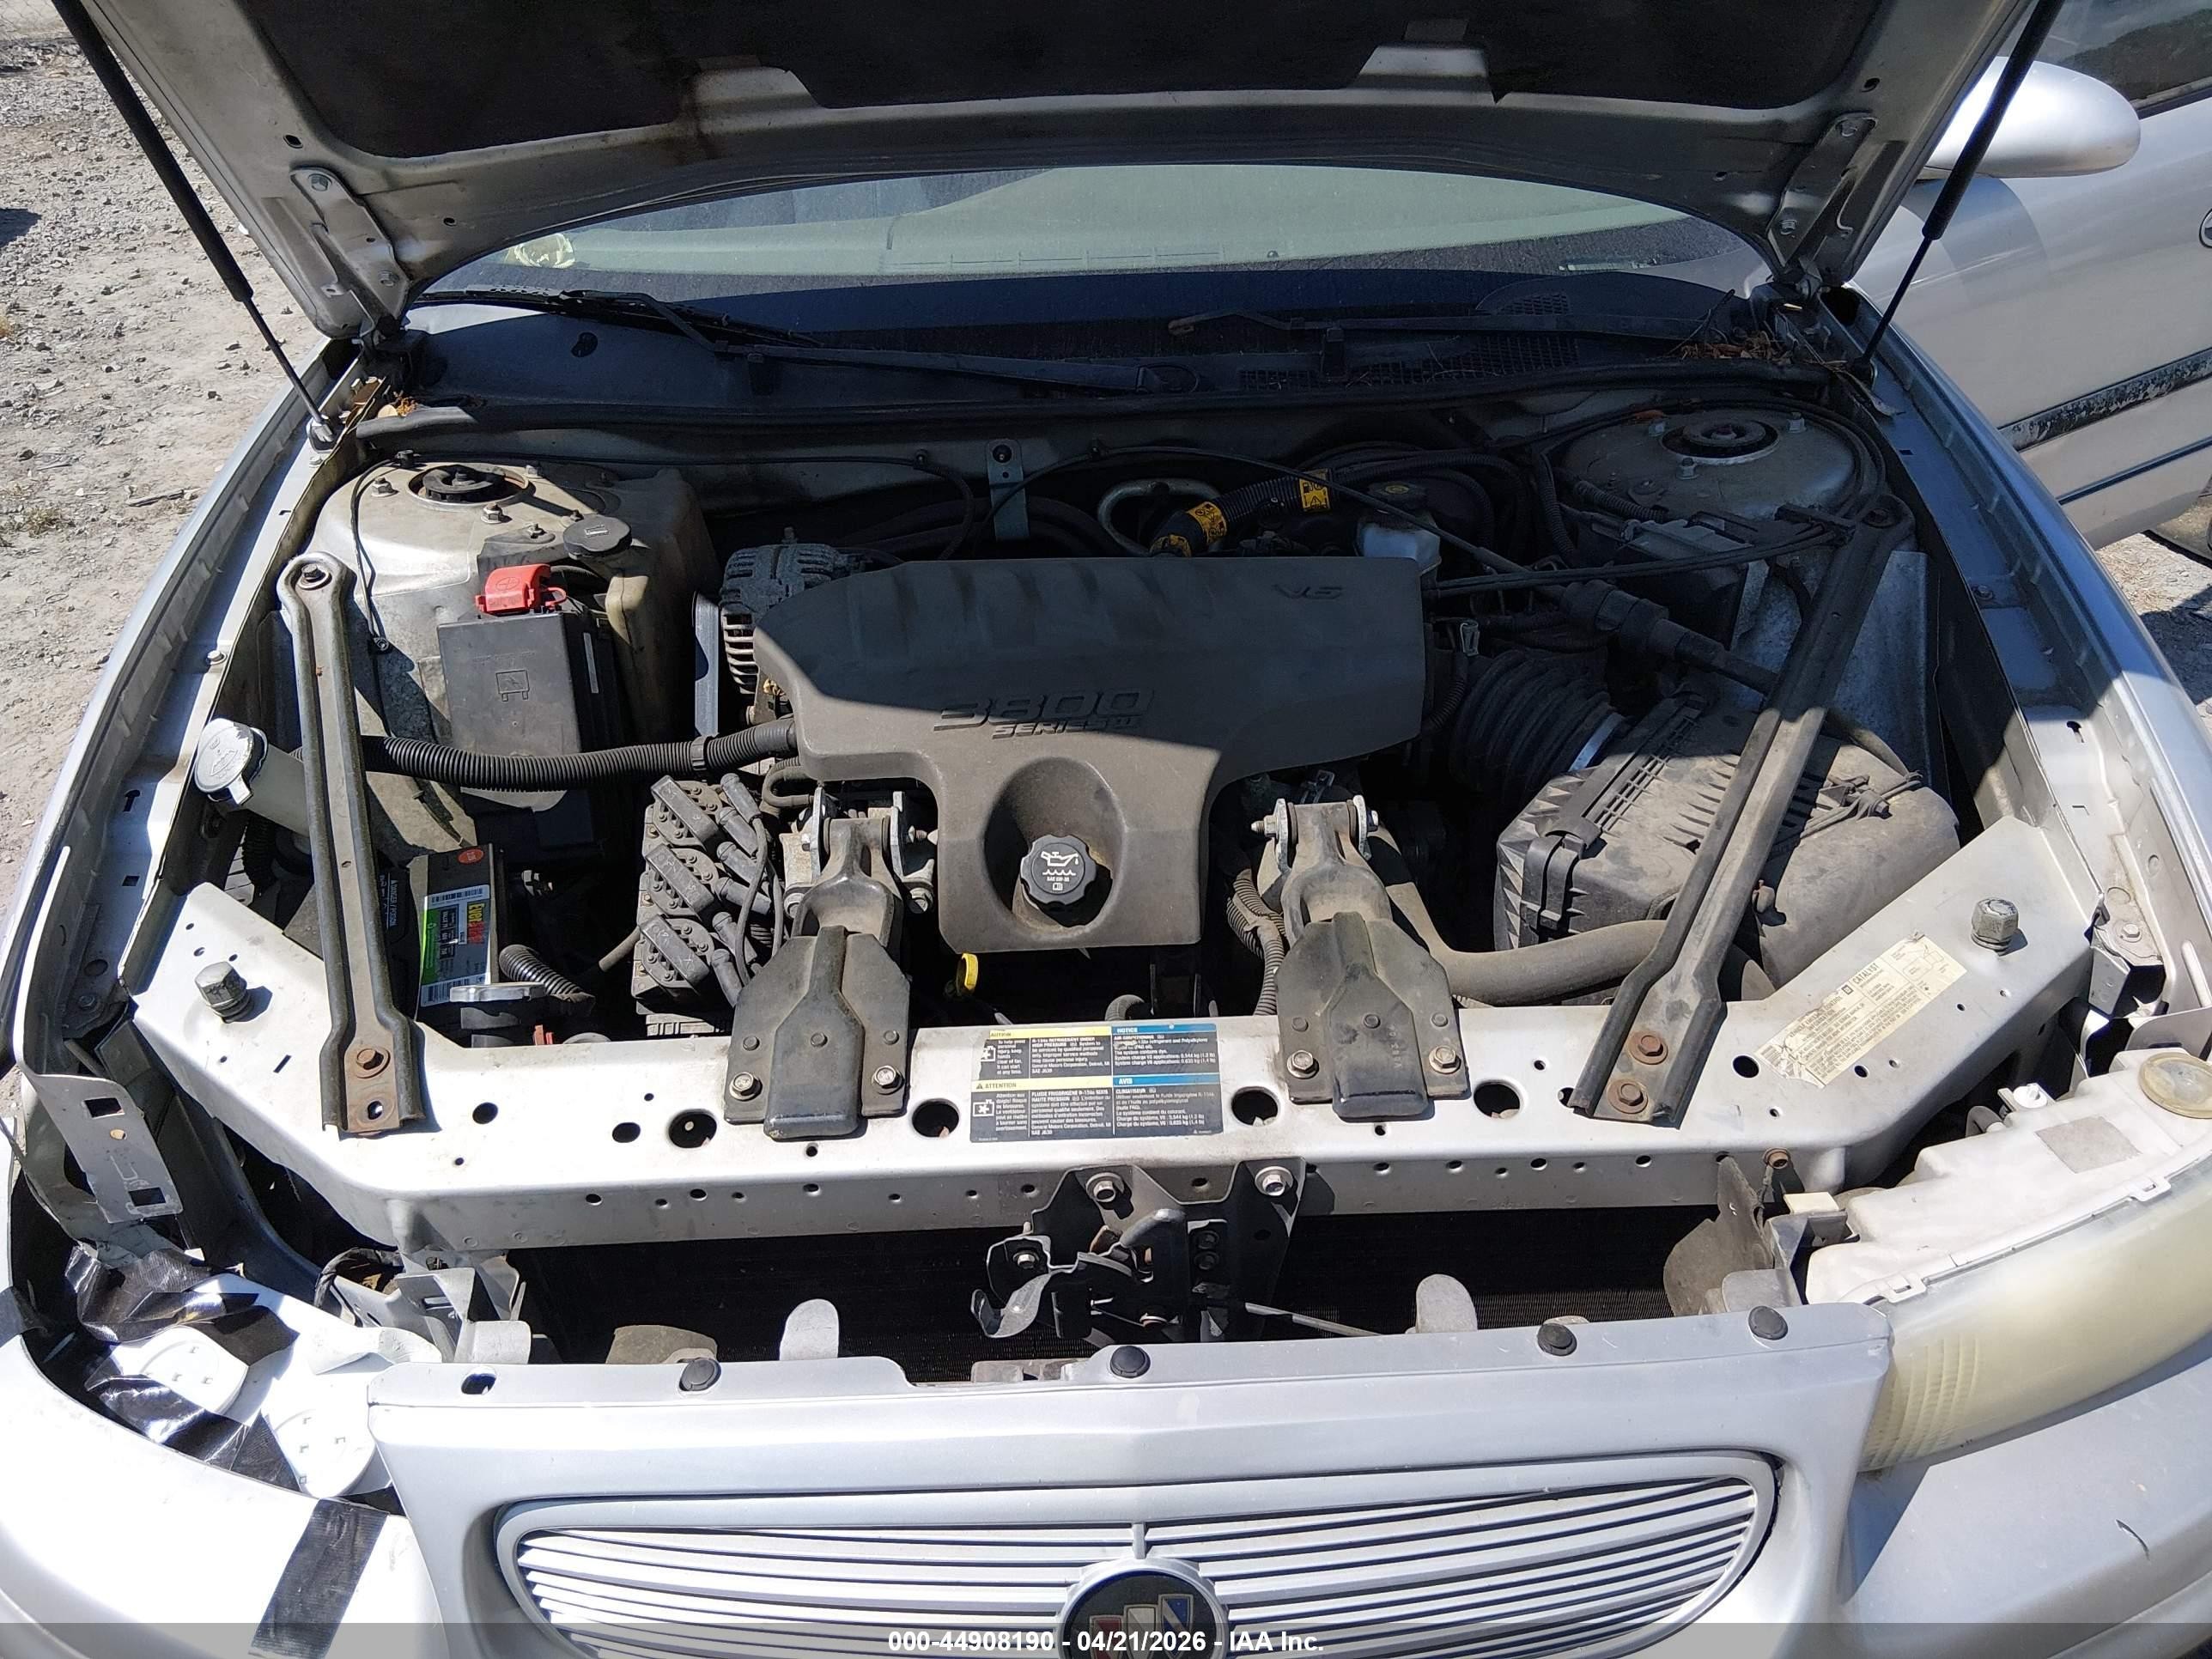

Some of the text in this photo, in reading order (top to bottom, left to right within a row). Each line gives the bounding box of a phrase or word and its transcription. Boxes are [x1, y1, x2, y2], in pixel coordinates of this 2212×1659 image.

[933, 690, 1155, 732] 3800
[992, 718, 1108, 739] SERIES
[1852, 962, 1880, 984] CATALYST
